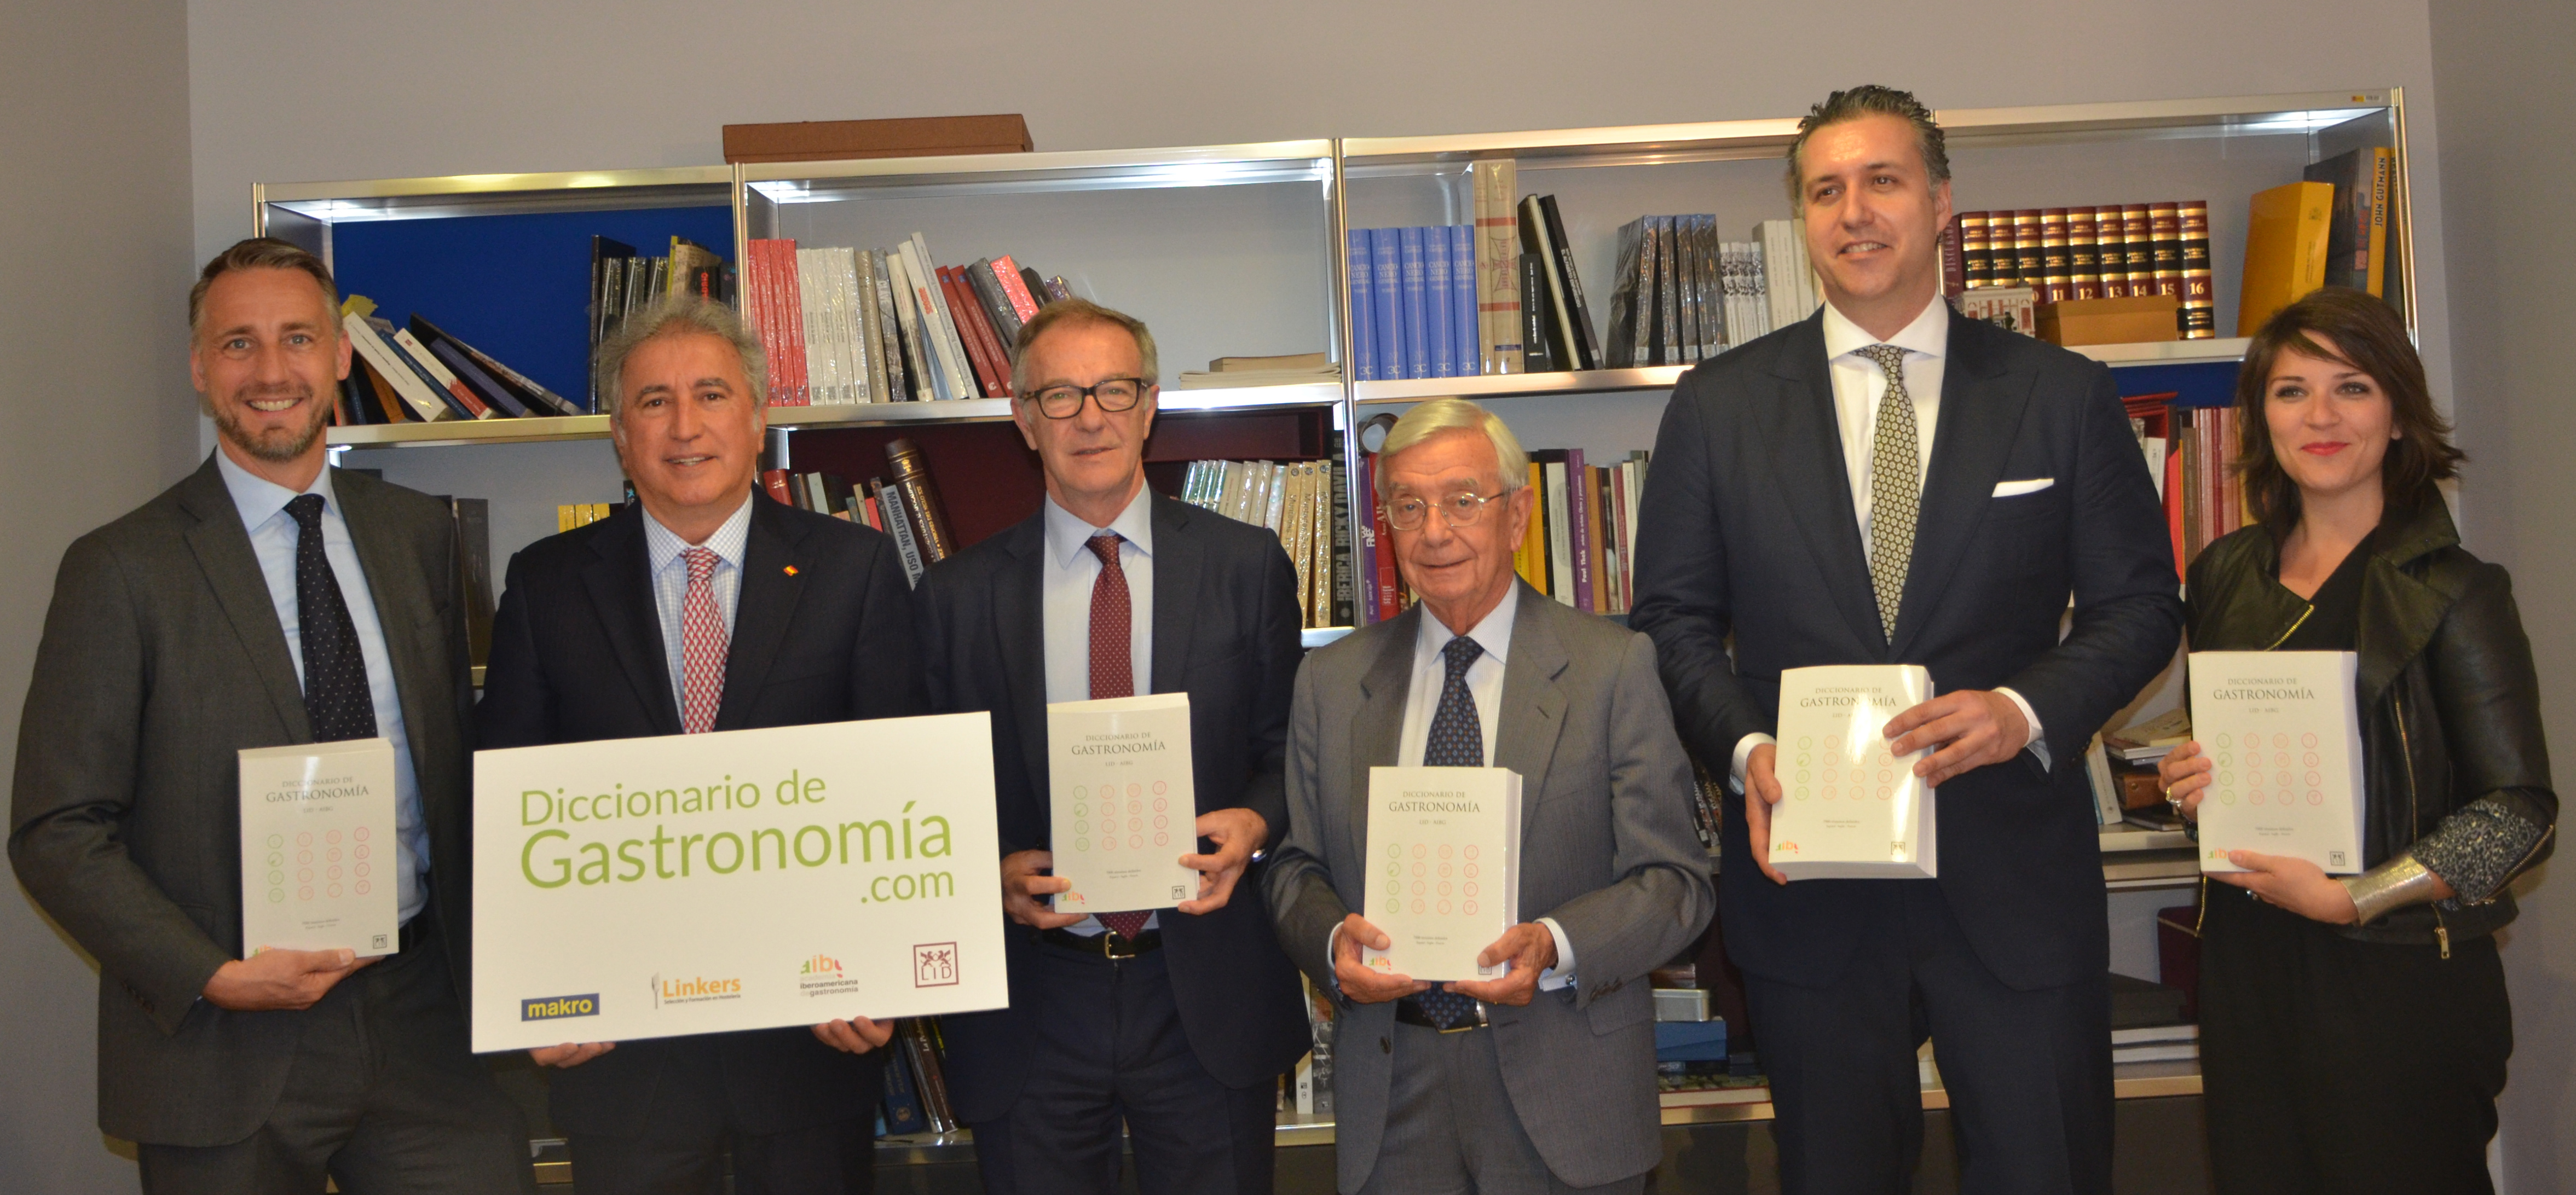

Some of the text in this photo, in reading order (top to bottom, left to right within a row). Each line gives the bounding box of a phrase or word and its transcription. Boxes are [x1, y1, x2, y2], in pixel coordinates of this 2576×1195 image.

[2376, 157, 2386, 200] GUTMANN
[2079, 288, 2093, 300] 12
[2109, 286, 2122, 298] 13
[2133, 285, 2147, 297] 14
[2161, 283, 2175, 295] 15
[2189, 282, 2204, 294] 16
[2052, 289, 2064, 301] 11
[886, 490, 912, 550] MANHATTAN,
[905, 550, 919, 571] USO
[2213, 687, 2314, 700] GASTRONOMÍA
[1800, 695, 1897, 707] GASTRONMÍA
[1085, 733, 1139, 742] DICCIONARIO
[1071, 739, 1166, 755] GASTRONOMÍA
[266, 784, 369, 803] GASTRONOMÍA
[522, 769, 827, 826] Diccionario de
[1389, 800, 1480, 813] GASTRONOMÍA
[520, 800, 952, 889] Gastronomía
[860, 871, 955, 904] .com
[921, 966, 952, 981] LID
[662, 977, 741, 998] Linkers
[800, 979, 858, 989] iberoamericana
[528, 997, 593, 1018] makro
